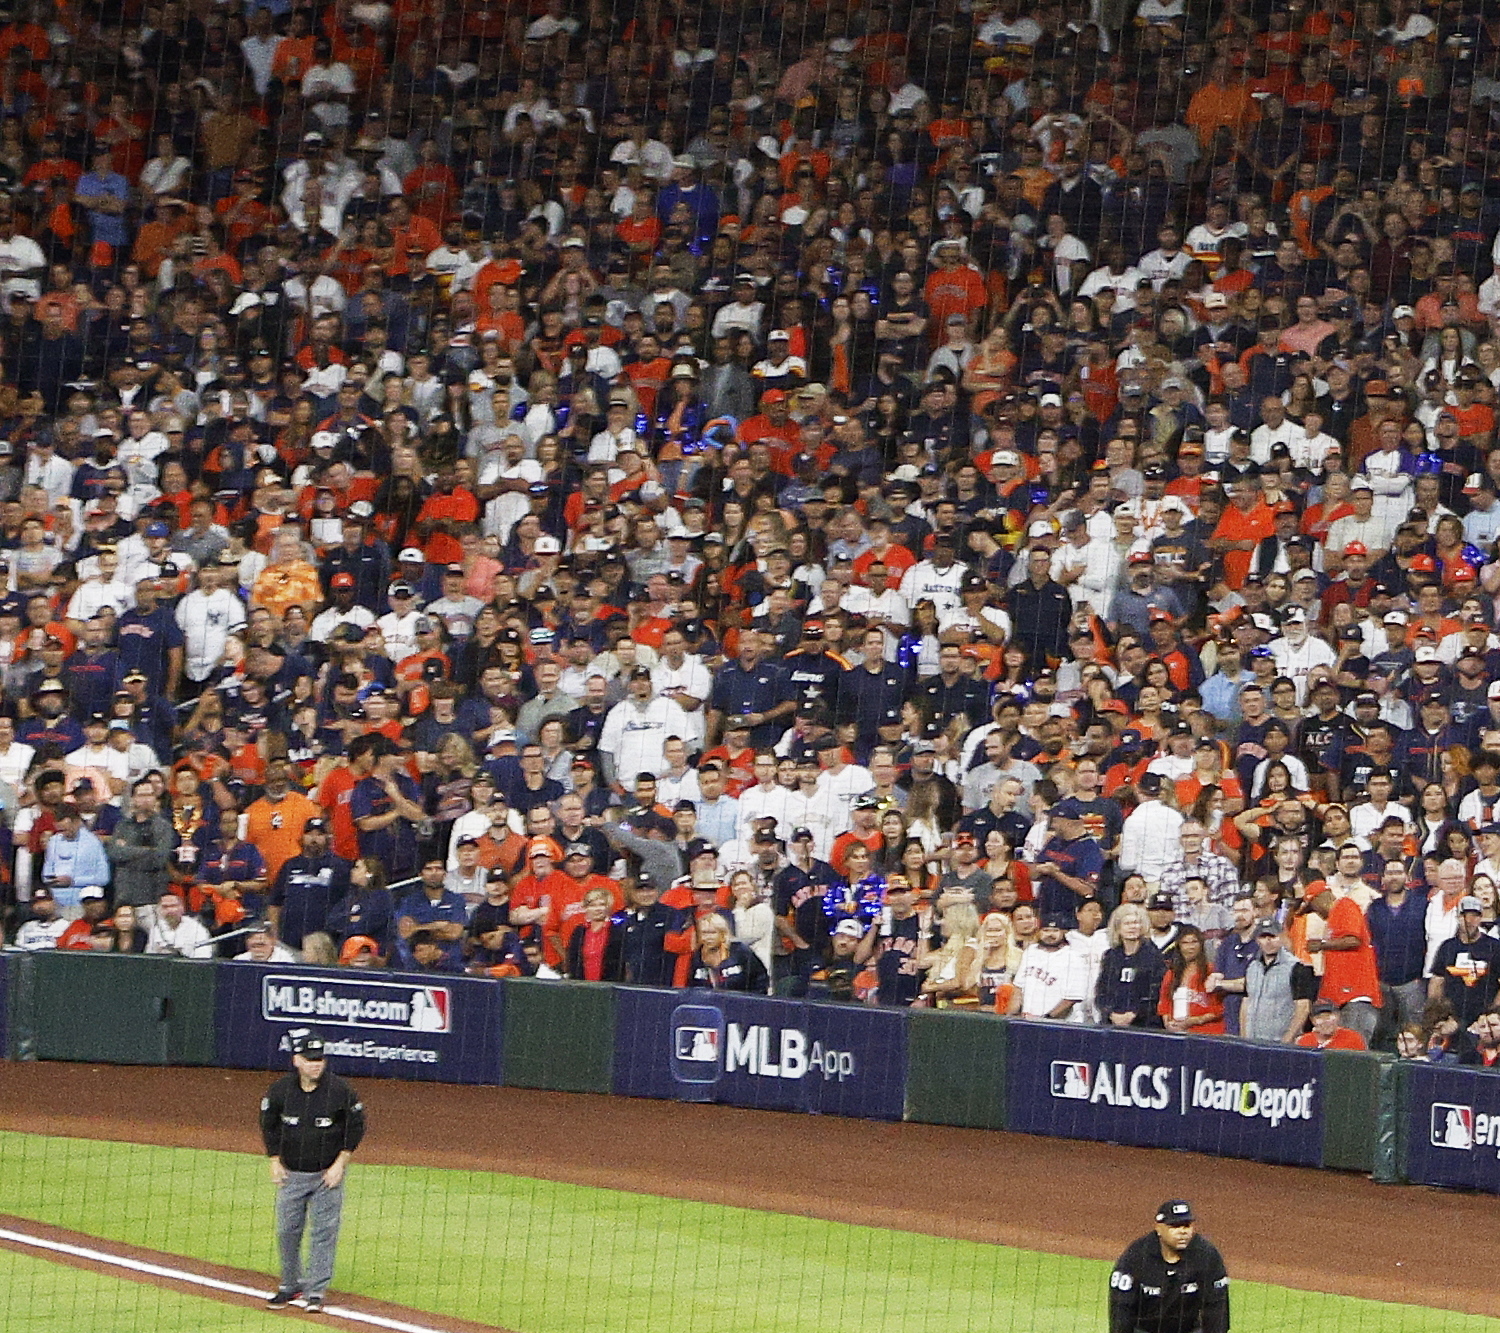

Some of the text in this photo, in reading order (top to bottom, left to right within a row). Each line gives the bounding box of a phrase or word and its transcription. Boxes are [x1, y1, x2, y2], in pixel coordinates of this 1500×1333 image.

[363, 1040, 438, 1063] Experience
[726, 1023, 855, 1082] MLB App
[1090, 1061, 1313, 1127] ALCS loanDepot
